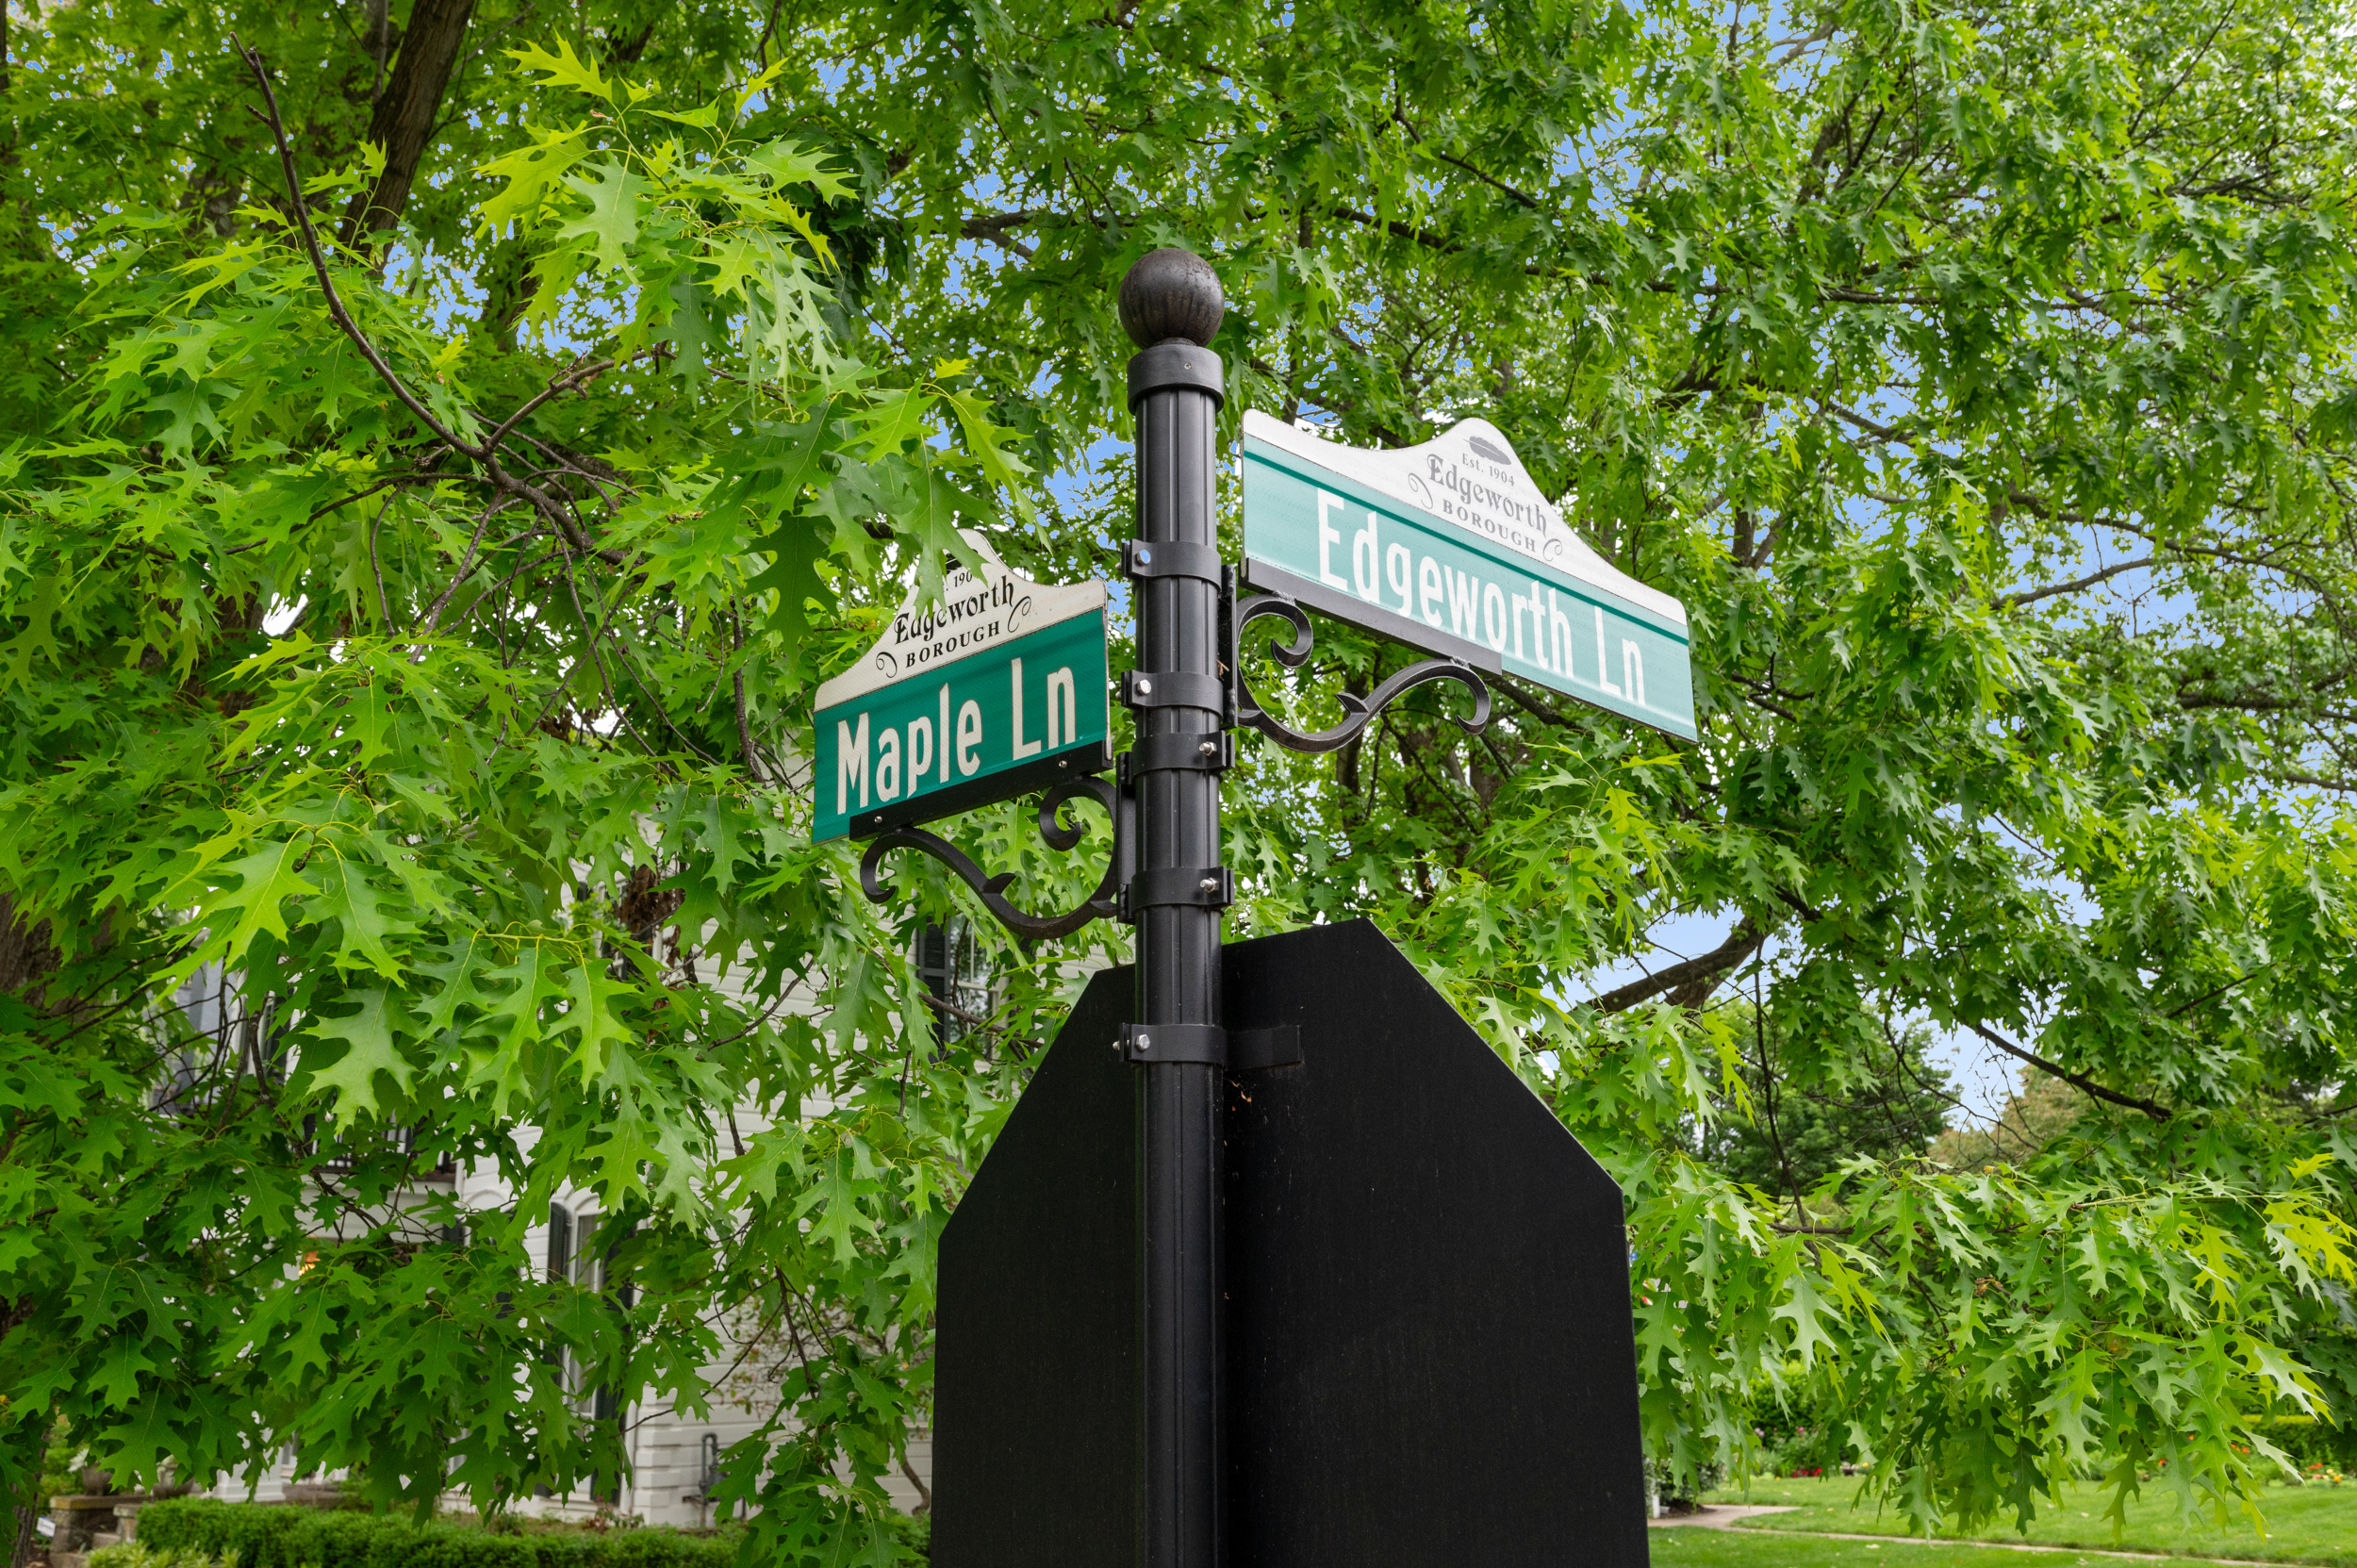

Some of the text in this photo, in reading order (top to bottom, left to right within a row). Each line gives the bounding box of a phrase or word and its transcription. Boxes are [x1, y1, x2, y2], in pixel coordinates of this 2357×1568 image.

[1426, 454, 1547, 538] Edgeworth
[1462, 453, 1515, 487] Est. 1904
[1442, 499, 1536, 553] BOROUGH
[953, 570, 974, 587] 190
[1317, 487, 1646, 705] Edgeworth Ln
[905, 620, 1000, 668] BOROUGH
[836, 657, 1077, 815] Maple Ln
